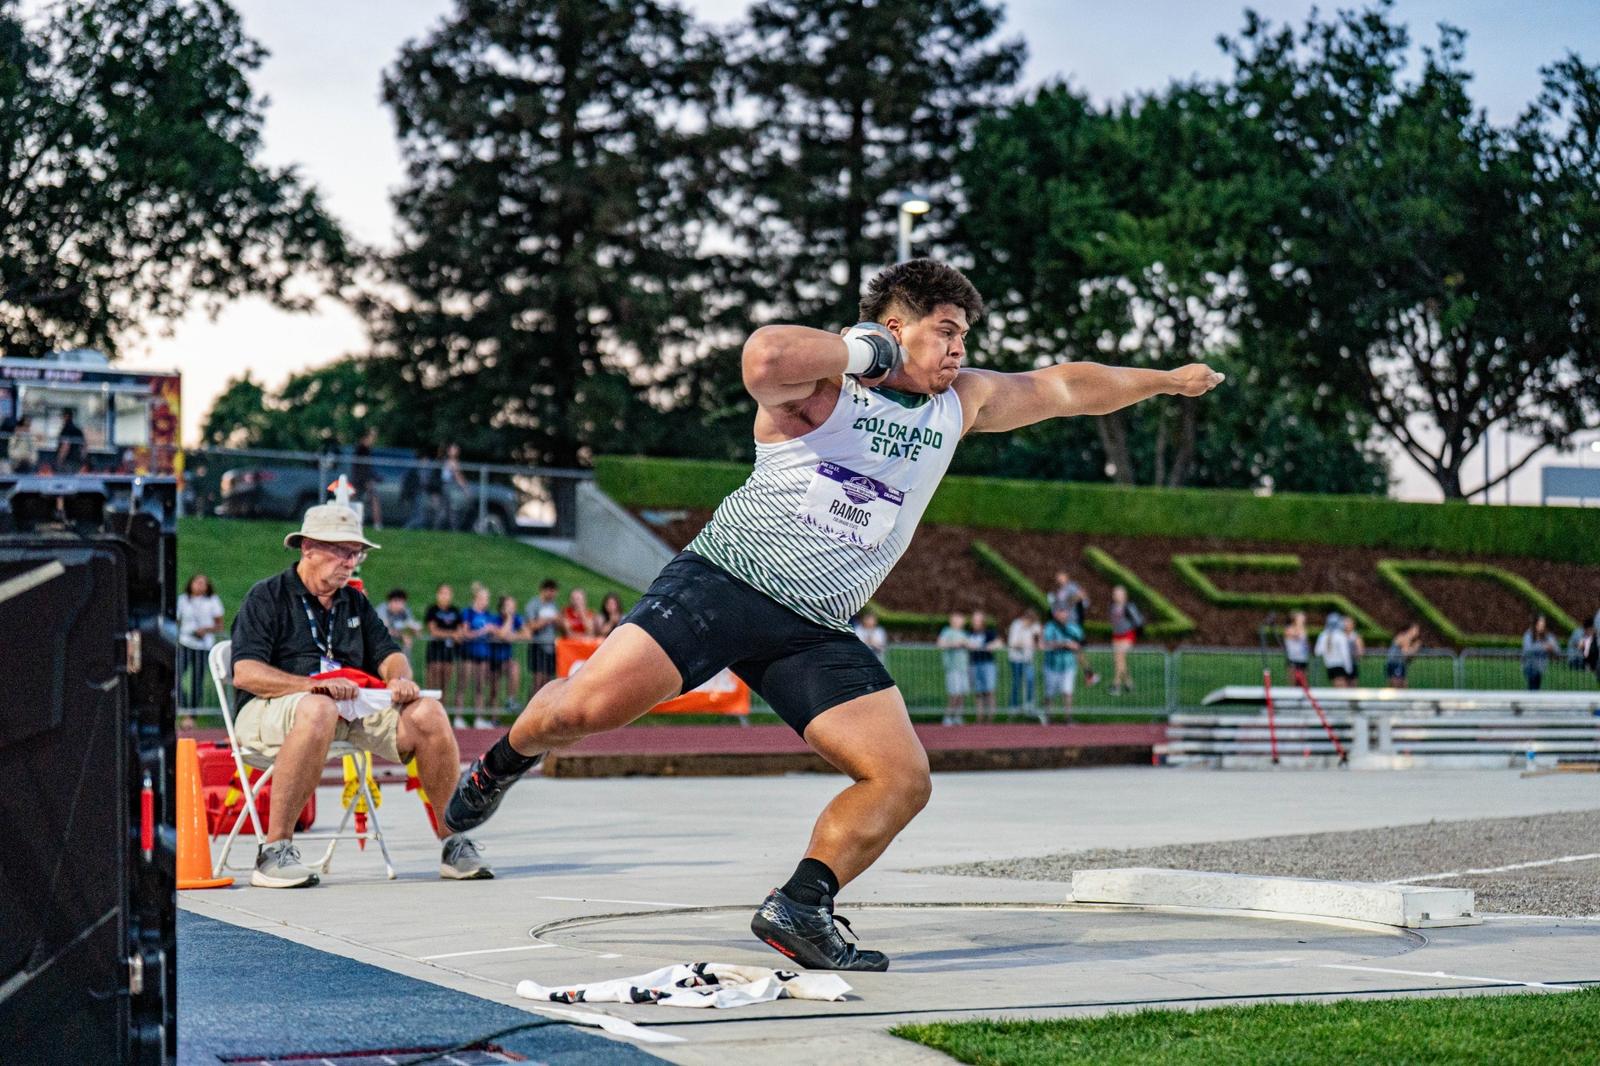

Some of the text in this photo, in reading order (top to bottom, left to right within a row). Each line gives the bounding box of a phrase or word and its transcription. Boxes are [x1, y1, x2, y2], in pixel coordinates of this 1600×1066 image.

[852, 417, 943, 449] COLORADO
[870, 436, 922, 462] STATE
[829, 499, 872, 527] RAMOS
[866, 539, 1582, 640] USD
